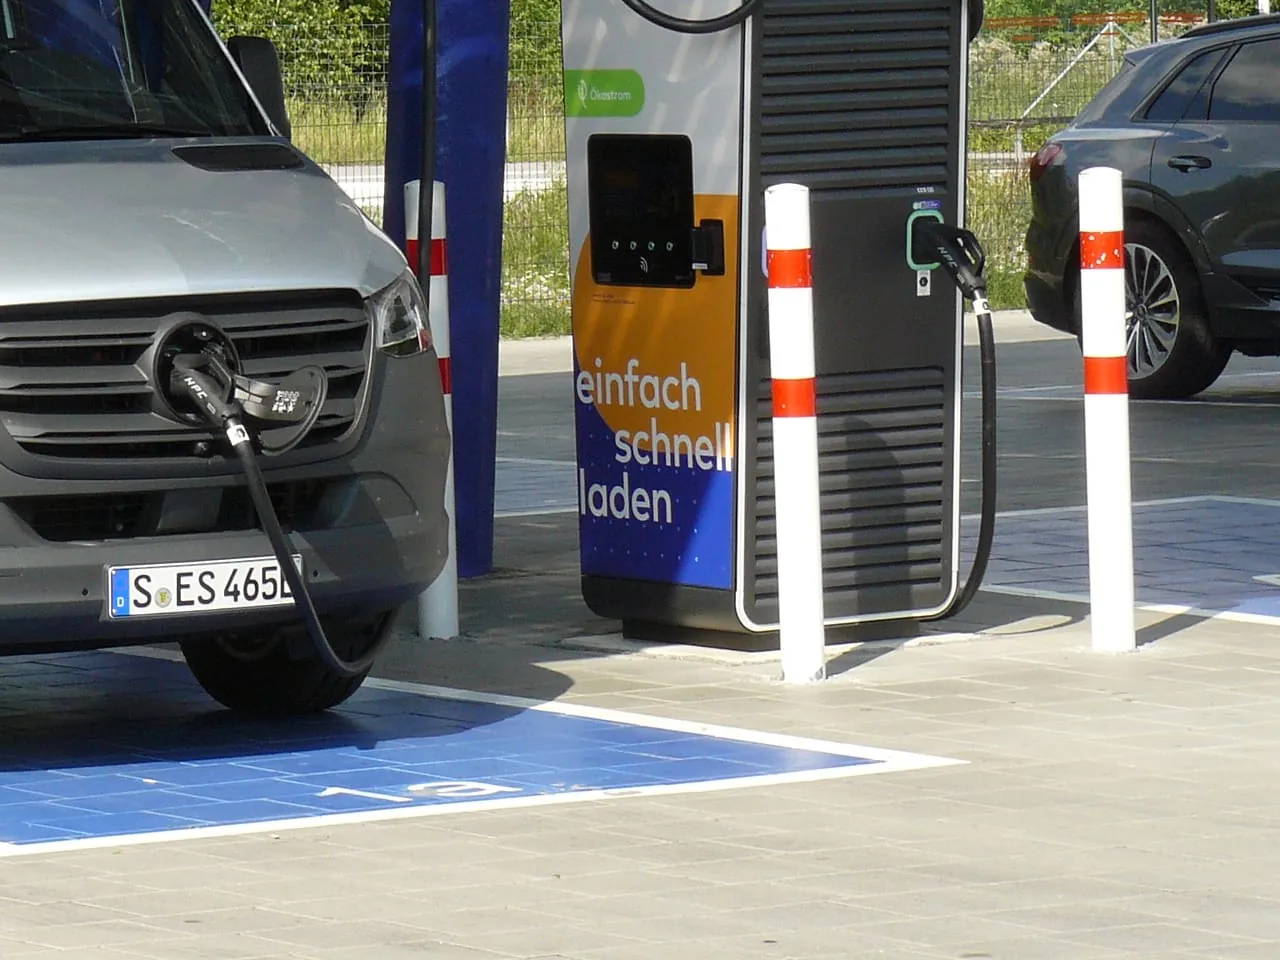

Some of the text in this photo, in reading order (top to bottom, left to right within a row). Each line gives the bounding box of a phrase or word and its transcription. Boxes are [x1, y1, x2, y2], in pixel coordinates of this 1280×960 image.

[184, 377, 208, 400] HPC
[576, 357, 702, 412] einfach
[615, 416, 732, 472] schnell
[579, 468, 672, 524] laden
[133, 574, 152, 608] S
[176, 571, 216, 607] ES
